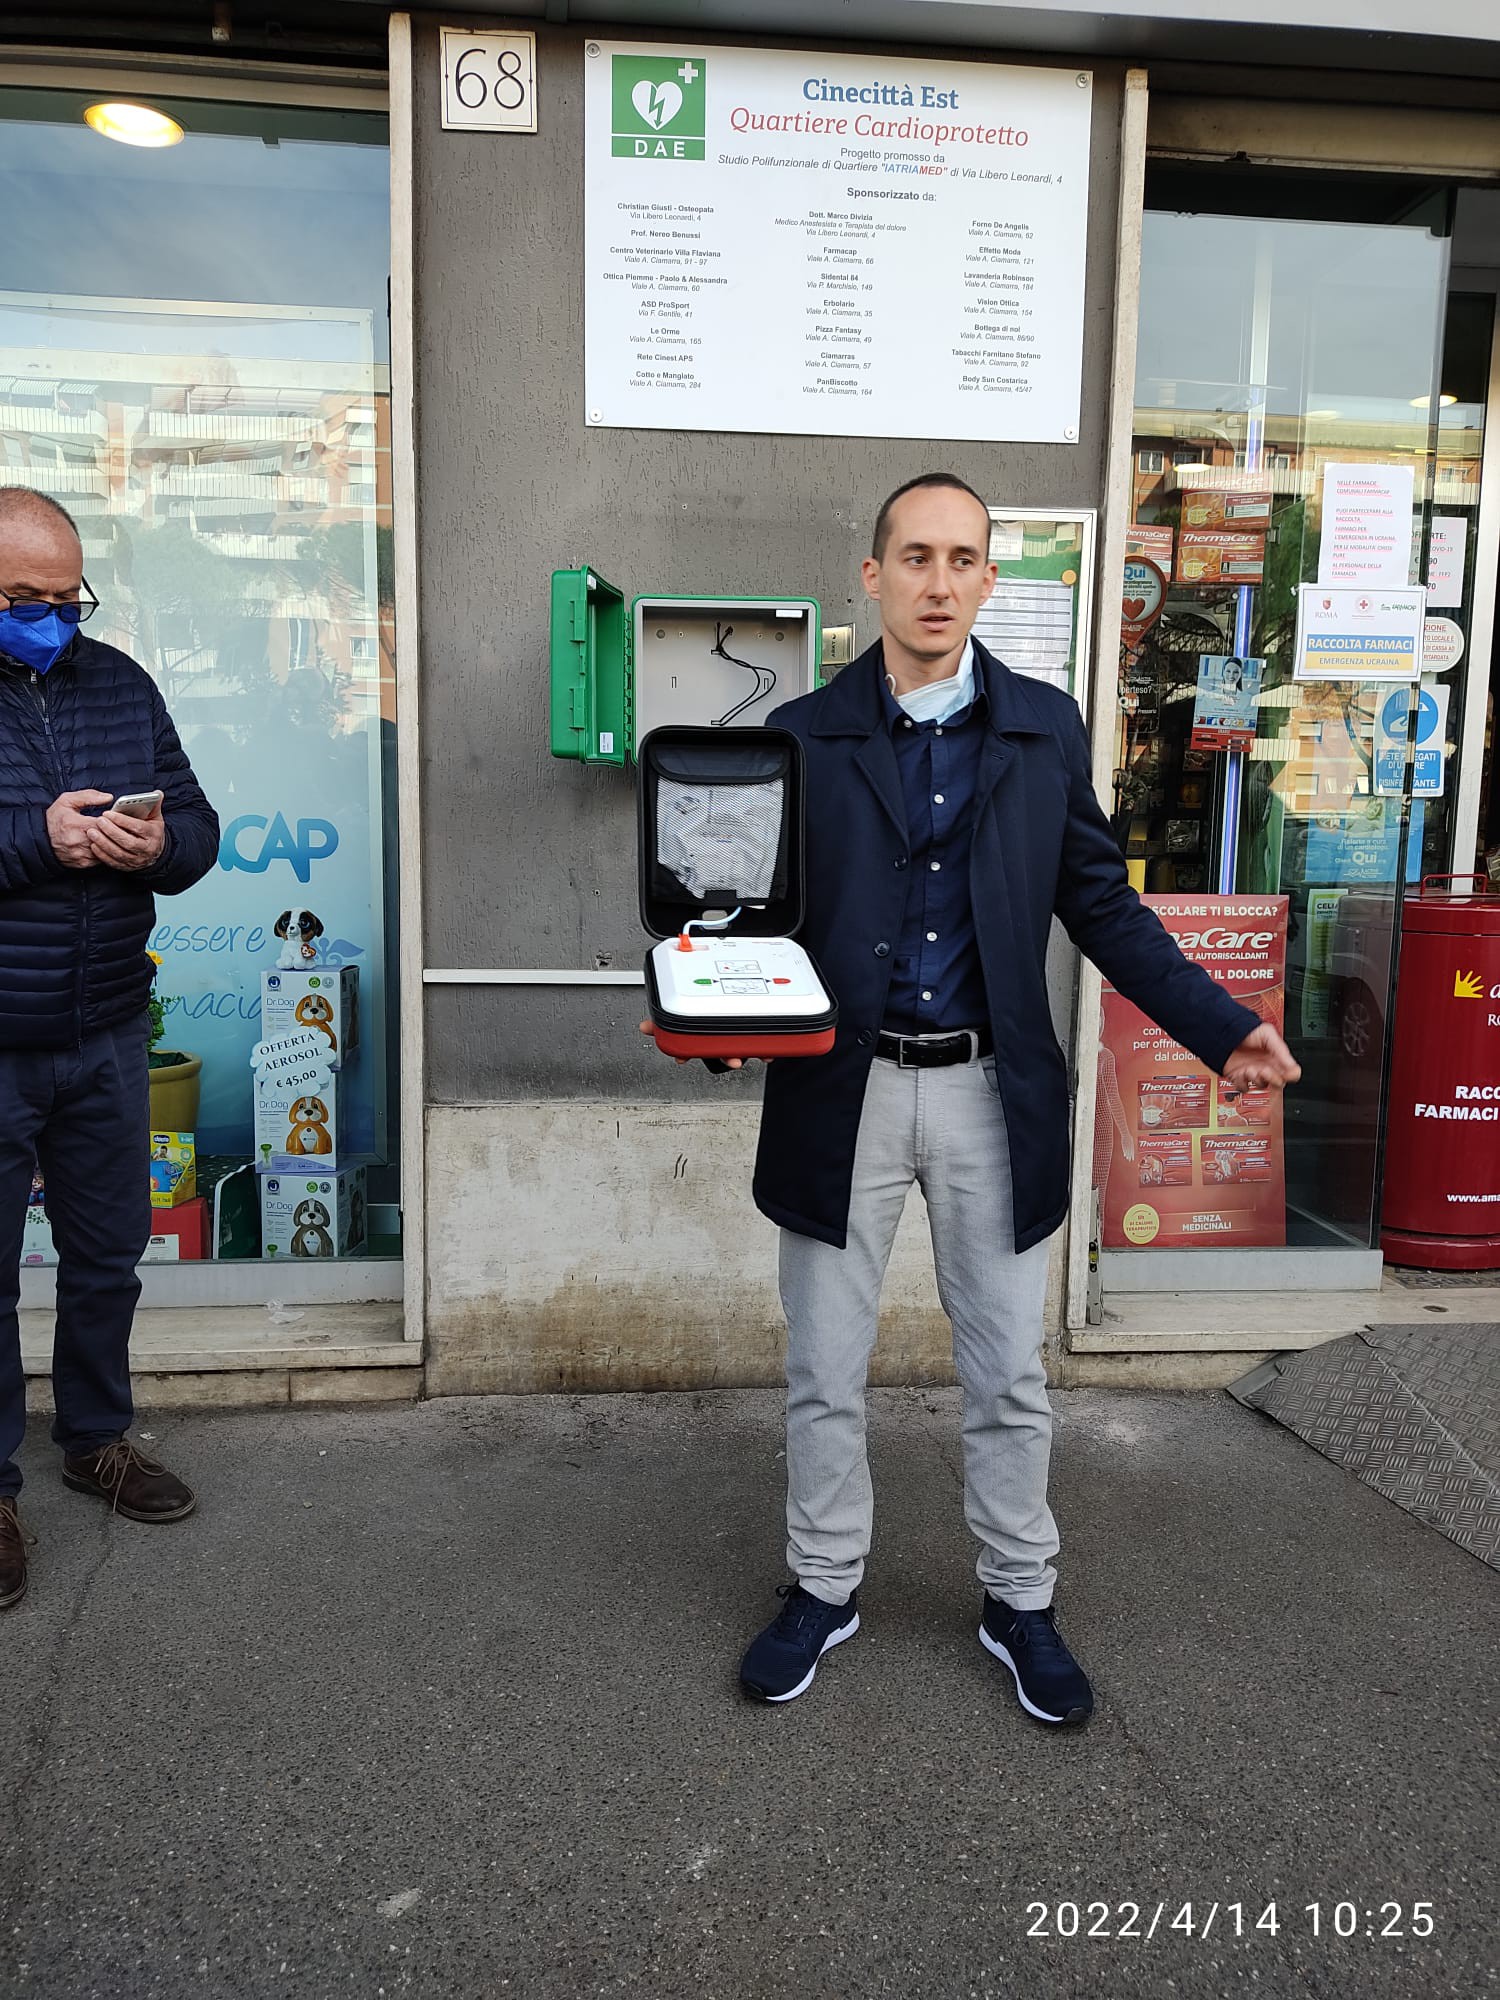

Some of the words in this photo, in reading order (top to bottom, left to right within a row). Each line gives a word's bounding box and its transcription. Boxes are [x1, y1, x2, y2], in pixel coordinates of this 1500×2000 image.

[454, 48, 526, 111] 68
[803, 79, 914, 107] Cinecittà
[920, 86, 959, 109] Est
[730, 107, 847, 134] Quartiere
[854, 115, 1028, 146] Cardioprotetto
[634, 139, 686, 157] DAE
[841, 148, 881, 160] Progetto
[884, 151, 931, 162] promosso
[934, 154, 945, 163] da
[718, 154, 749, 166] Studio
[752, 156, 819, 169] Polifunzionale
[822, 160, 831, 169] di
[834, 161, 878, 172] Quartiere
[881, 163, 947, 176] "IATRIAMED"
[950, 168, 959, 177] di
[962, 168, 976, 178] Via
[979, 170, 1008, 181] Libero
[1011, 172, 1054, 184] Leonardi,
[1057, 175, 1062, 183] 4
[847, 187, 920, 201] Sponsorizzato
[922, 192, 936, 202] da:
[840, 230, 869, 239] Leonardi,
[824, 247, 857, 255] Farmacap
[689, 276, 727, 284] Alessandra
[659, 301, 689, 310] ProSport
[835, 327, 862, 335] Fantasy
[663, 372, 694, 380] Mangiato
[817, 378, 858, 386] PanBiscotto
[1183, 534, 1259, 542] ThermaCare
[1308, 639, 1360, 649] RACCOLTA
[1365, 640, 1412, 650] FARMACI
[1119, 697, 1139, 709] Qui
[219, 811, 339, 883] CAP
[1352, 852, 1377, 866] Qui
[1151, 906, 1207, 916] SCOLARE
[1210, 906, 1221, 916] TI
[1222, 906, 1278, 917] BLOCCA?
[147, 923, 266, 953] essere
[1215, 970, 1225, 979] IL
[1228, 969, 1273, 979] DOLORE
[267, 998, 294, 1006] Dr.Dog
[1143, 1028, 1161, 1036] con
[260, 1032, 315, 1056] OFFERTA
[1133, 1040, 1151, 1050] per
[1153, 1039, 1182, 1049] offrire
[265, 1048, 322, 1072] AEROSOL
[1172, 1052, 1200, 1061] dolor
[286, 1070, 316, 1088] 45,00
[259, 1101, 288, 1110] Dr.Dog
[1415, 1104, 1498, 1120] FARMACI
[1205, 1140, 1268, 1148] ThermaCare
[266, 1202, 293, 1211] Dr.Dog
[1182, 1223, 1231, 1231] MEDICINALI
